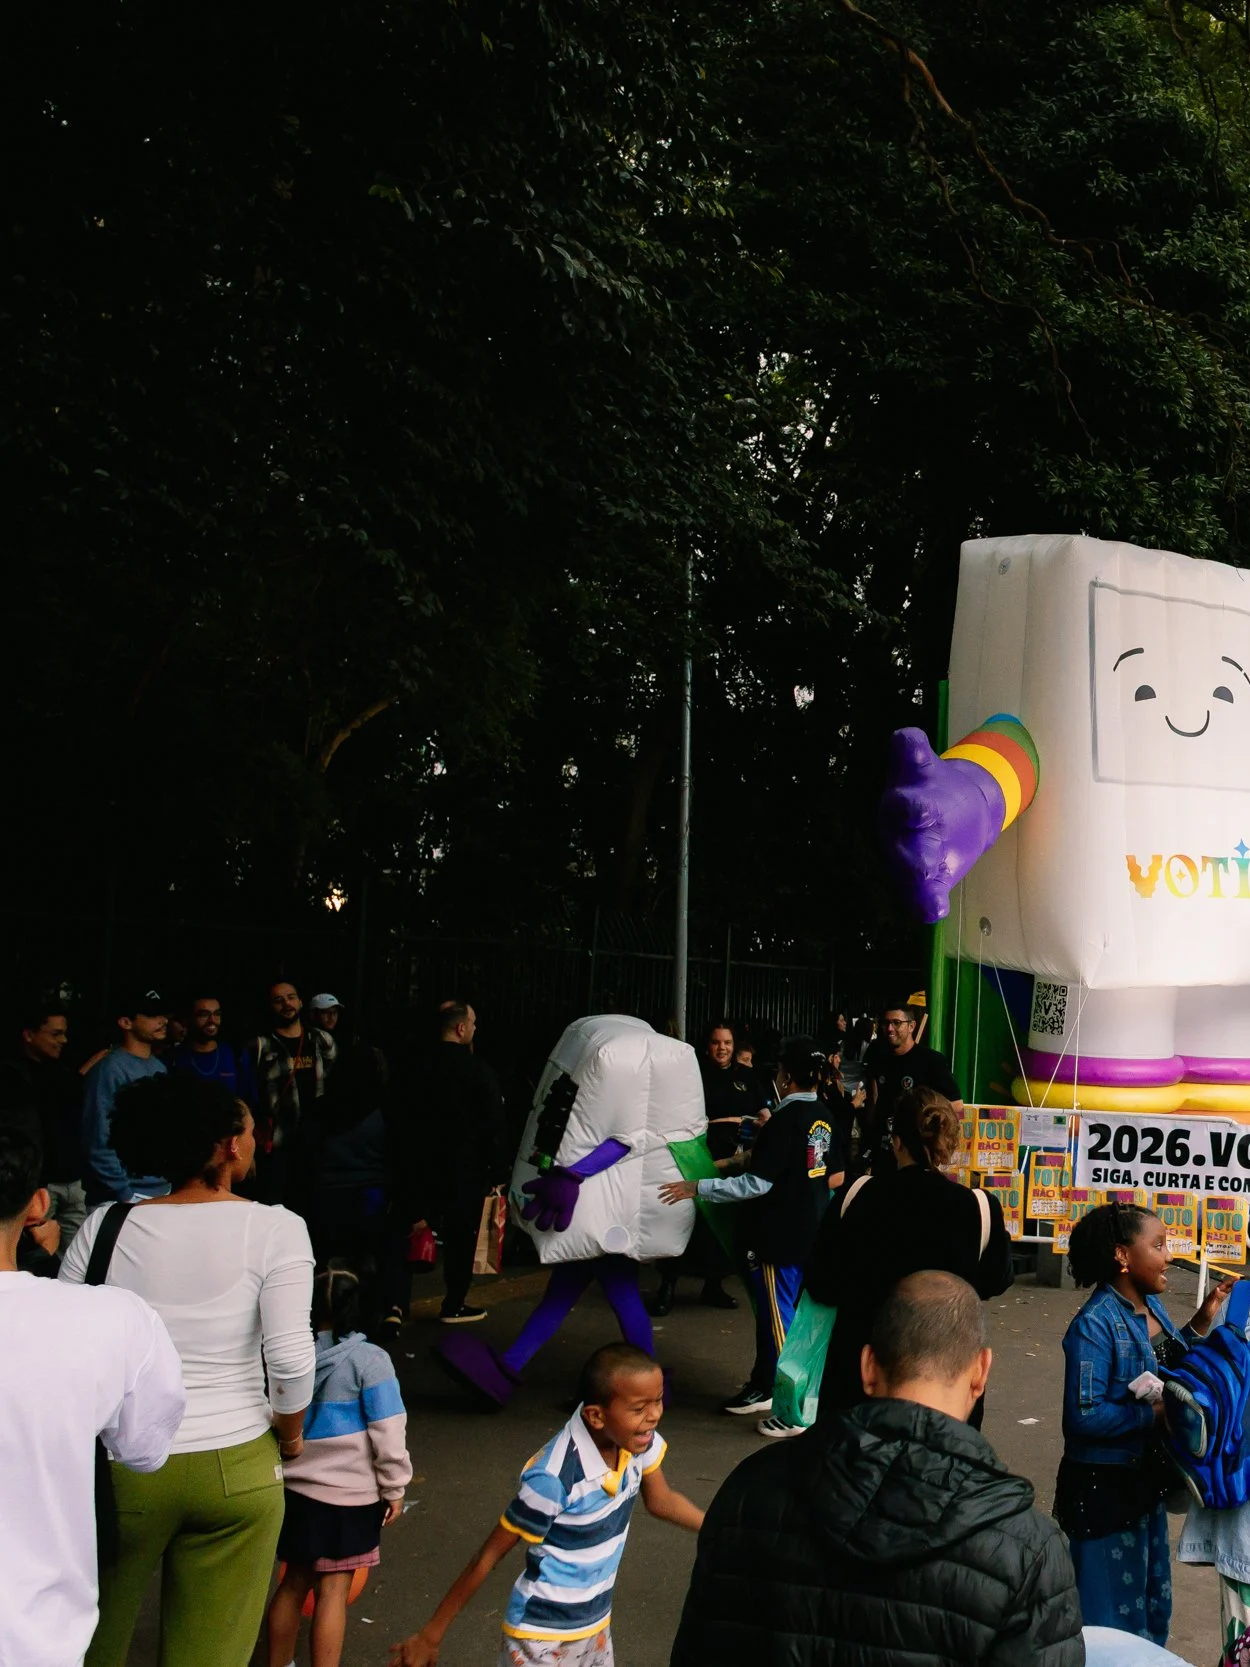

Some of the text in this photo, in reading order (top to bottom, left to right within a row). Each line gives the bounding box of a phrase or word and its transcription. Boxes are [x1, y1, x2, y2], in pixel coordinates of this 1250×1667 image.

[978, 1121, 1014, 1140] VOTO
[1034, 1168, 1070, 1188] VOTO
[1092, 1167, 1139, 1188] SIGA,
[1143, 1171, 1200, 1190] CURTA
[1205, 1175, 1215, 1190] E
[992, 1190, 1019, 1209] OTO
[1207, 1212, 1243, 1232] VOTO
